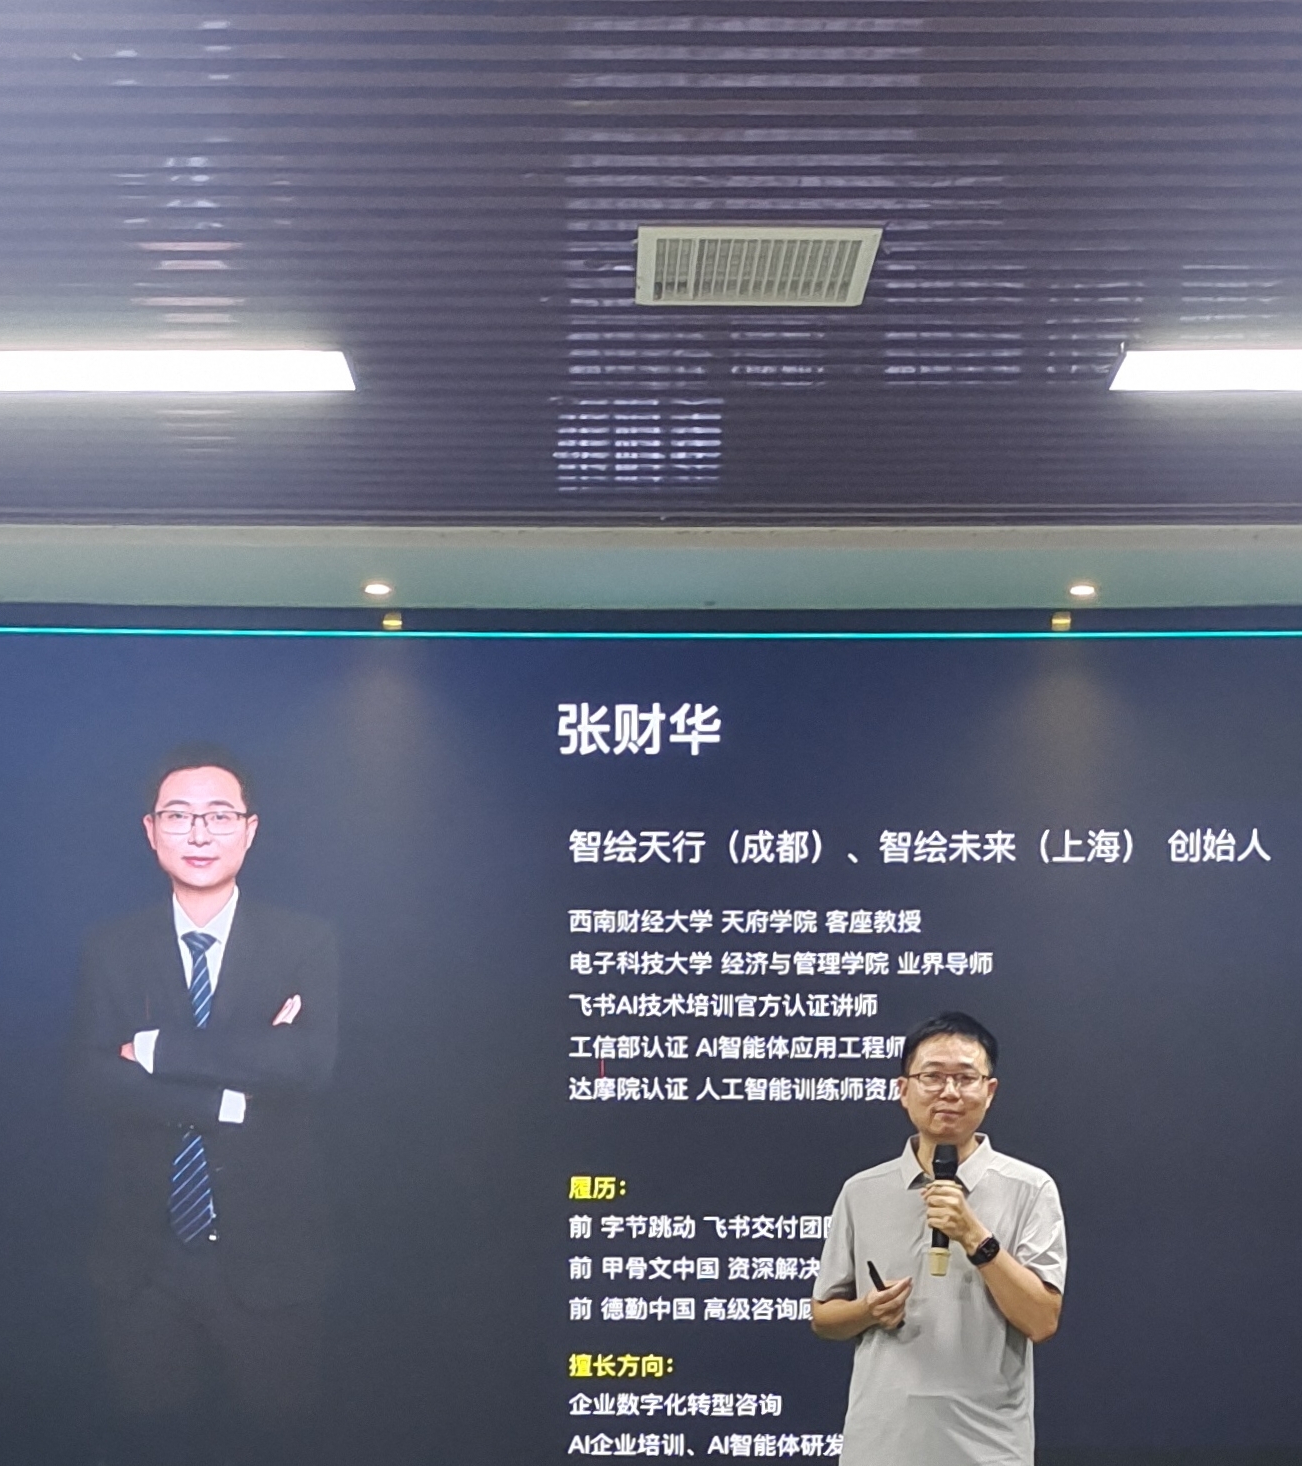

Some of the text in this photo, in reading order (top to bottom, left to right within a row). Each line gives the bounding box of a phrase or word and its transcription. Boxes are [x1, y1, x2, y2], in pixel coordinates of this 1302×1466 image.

[558, 702, 722, 756] 张财华
[1167, 827, 1272, 863] 创始人
[568, 908, 922, 934] 西南财经大学 天府学院 客座教授
[569, 950, 994, 976] 电子科技大学 经济与管理学院 业界导师
[568, 992, 878, 1018] 飞书AI技术培训官方认证讲师
[568, 1034, 689, 1060] 工信部认证
[568, 1076, 689, 1102] 达摩院认证
[568, 1214, 593, 1239] 前
[600, 1214, 696, 1239] 字节跳动
[568, 1255, 593, 1280] 前
[602, 1255, 720, 1281] 甲骨文中国
[568, 1296, 593, 1321] 前
[600, 1295, 696, 1321] 德勤中国
[568, 1392, 782, 1417] 企业数字化转型咨询
